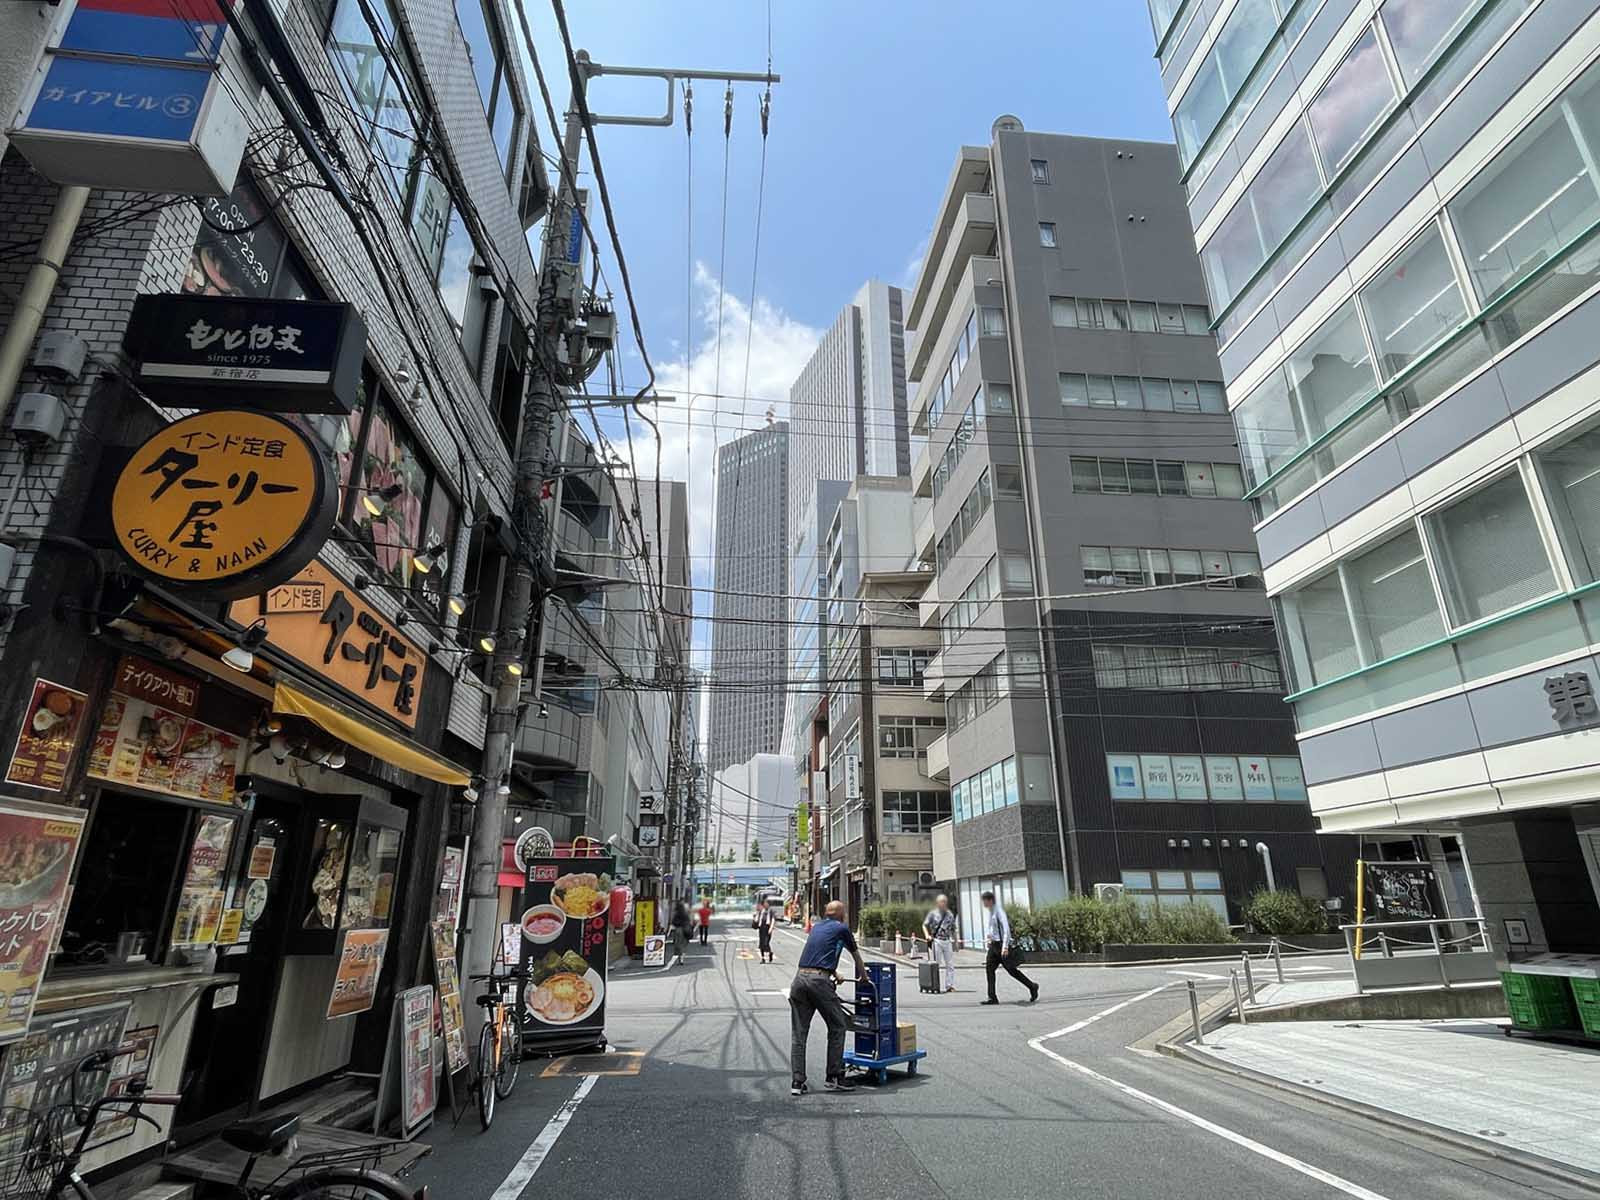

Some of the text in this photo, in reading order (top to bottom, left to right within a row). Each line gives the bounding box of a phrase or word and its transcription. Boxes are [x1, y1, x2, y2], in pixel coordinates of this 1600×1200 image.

[207, 352, 271, 365] since 1975
[211, 366, 261, 380] 新宿店
[181, 431, 288, 459] インド定食
[139, 446, 299, 505] ターリー
[167, 499, 223, 550] 屋
[127, 527, 268, 573] CURRY & NAAN
[269, 587, 322, 609] インド定食
[1543, 671, 1597, 722] 第
[1148, 771, 1168, 783] 新宿
[1247, 772, 1266, 783] 外科
